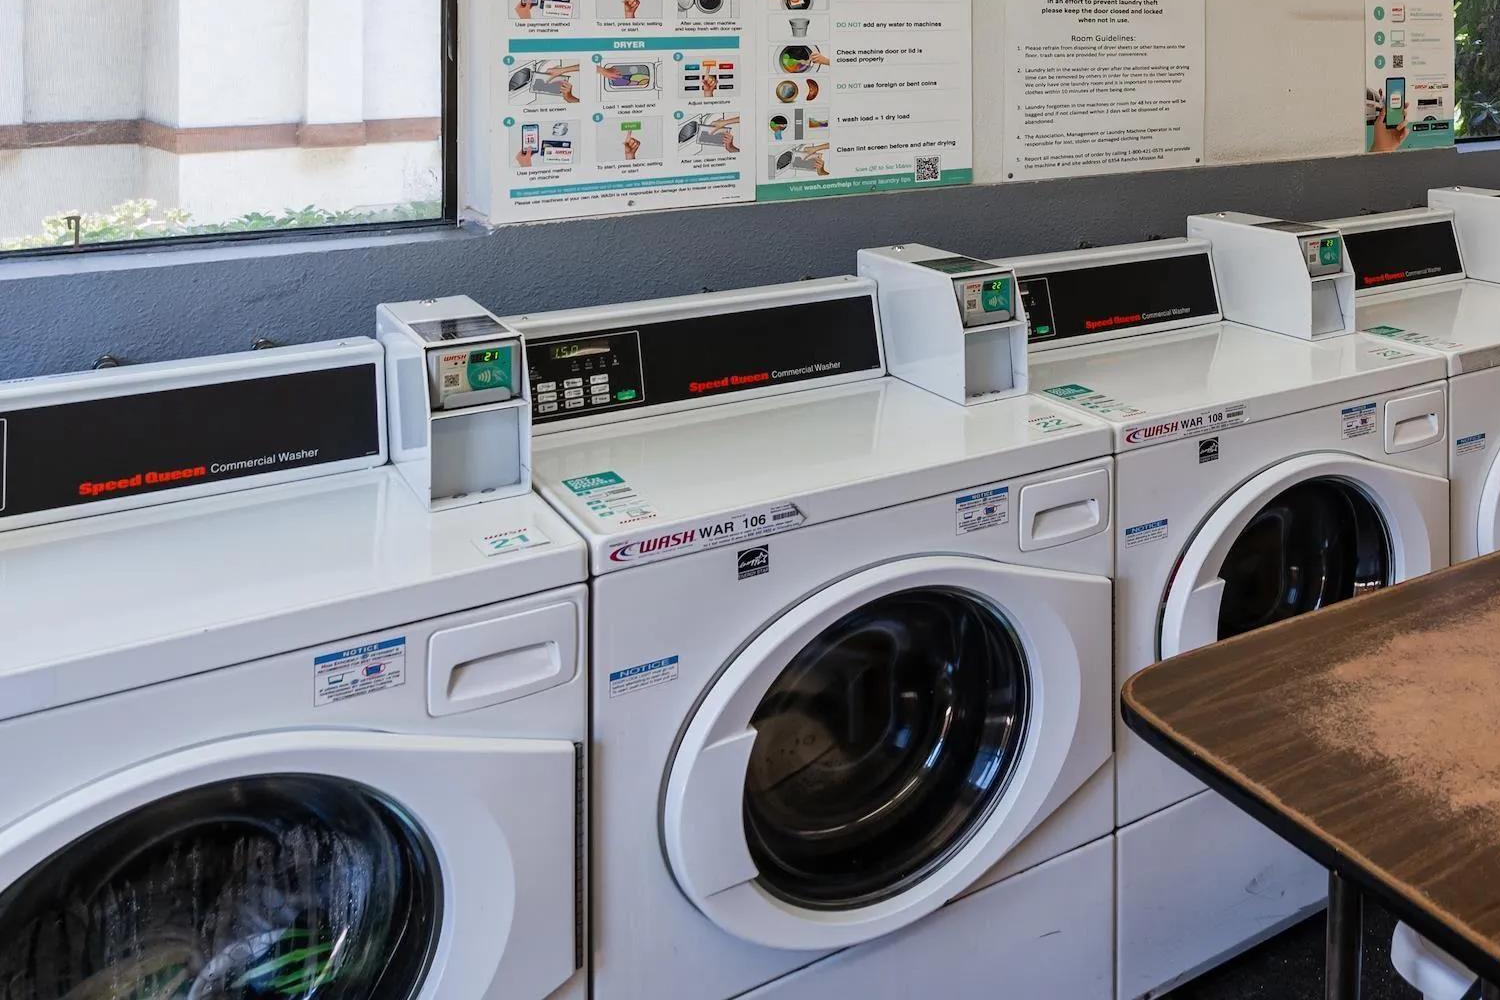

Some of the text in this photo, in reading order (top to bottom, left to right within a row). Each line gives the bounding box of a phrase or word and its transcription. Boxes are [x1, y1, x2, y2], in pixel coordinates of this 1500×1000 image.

[992, 281, 1002, 290] 22
[484, 351, 498, 361] 21
[688, 361, 841, 392] Speed Queen Commercial Washer
[1144, 413, 1223, 437] WASH WAR 108
[79, 448, 319, 496] Speed Queen Commercial Washer
[639, 529, 695, 554] WASH
[699, 521, 734, 539] WAR
[742, 514, 766, 529] 106
[342, 644, 380, 657] NOTICE
[620, 659, 670, 678] NOTICE
